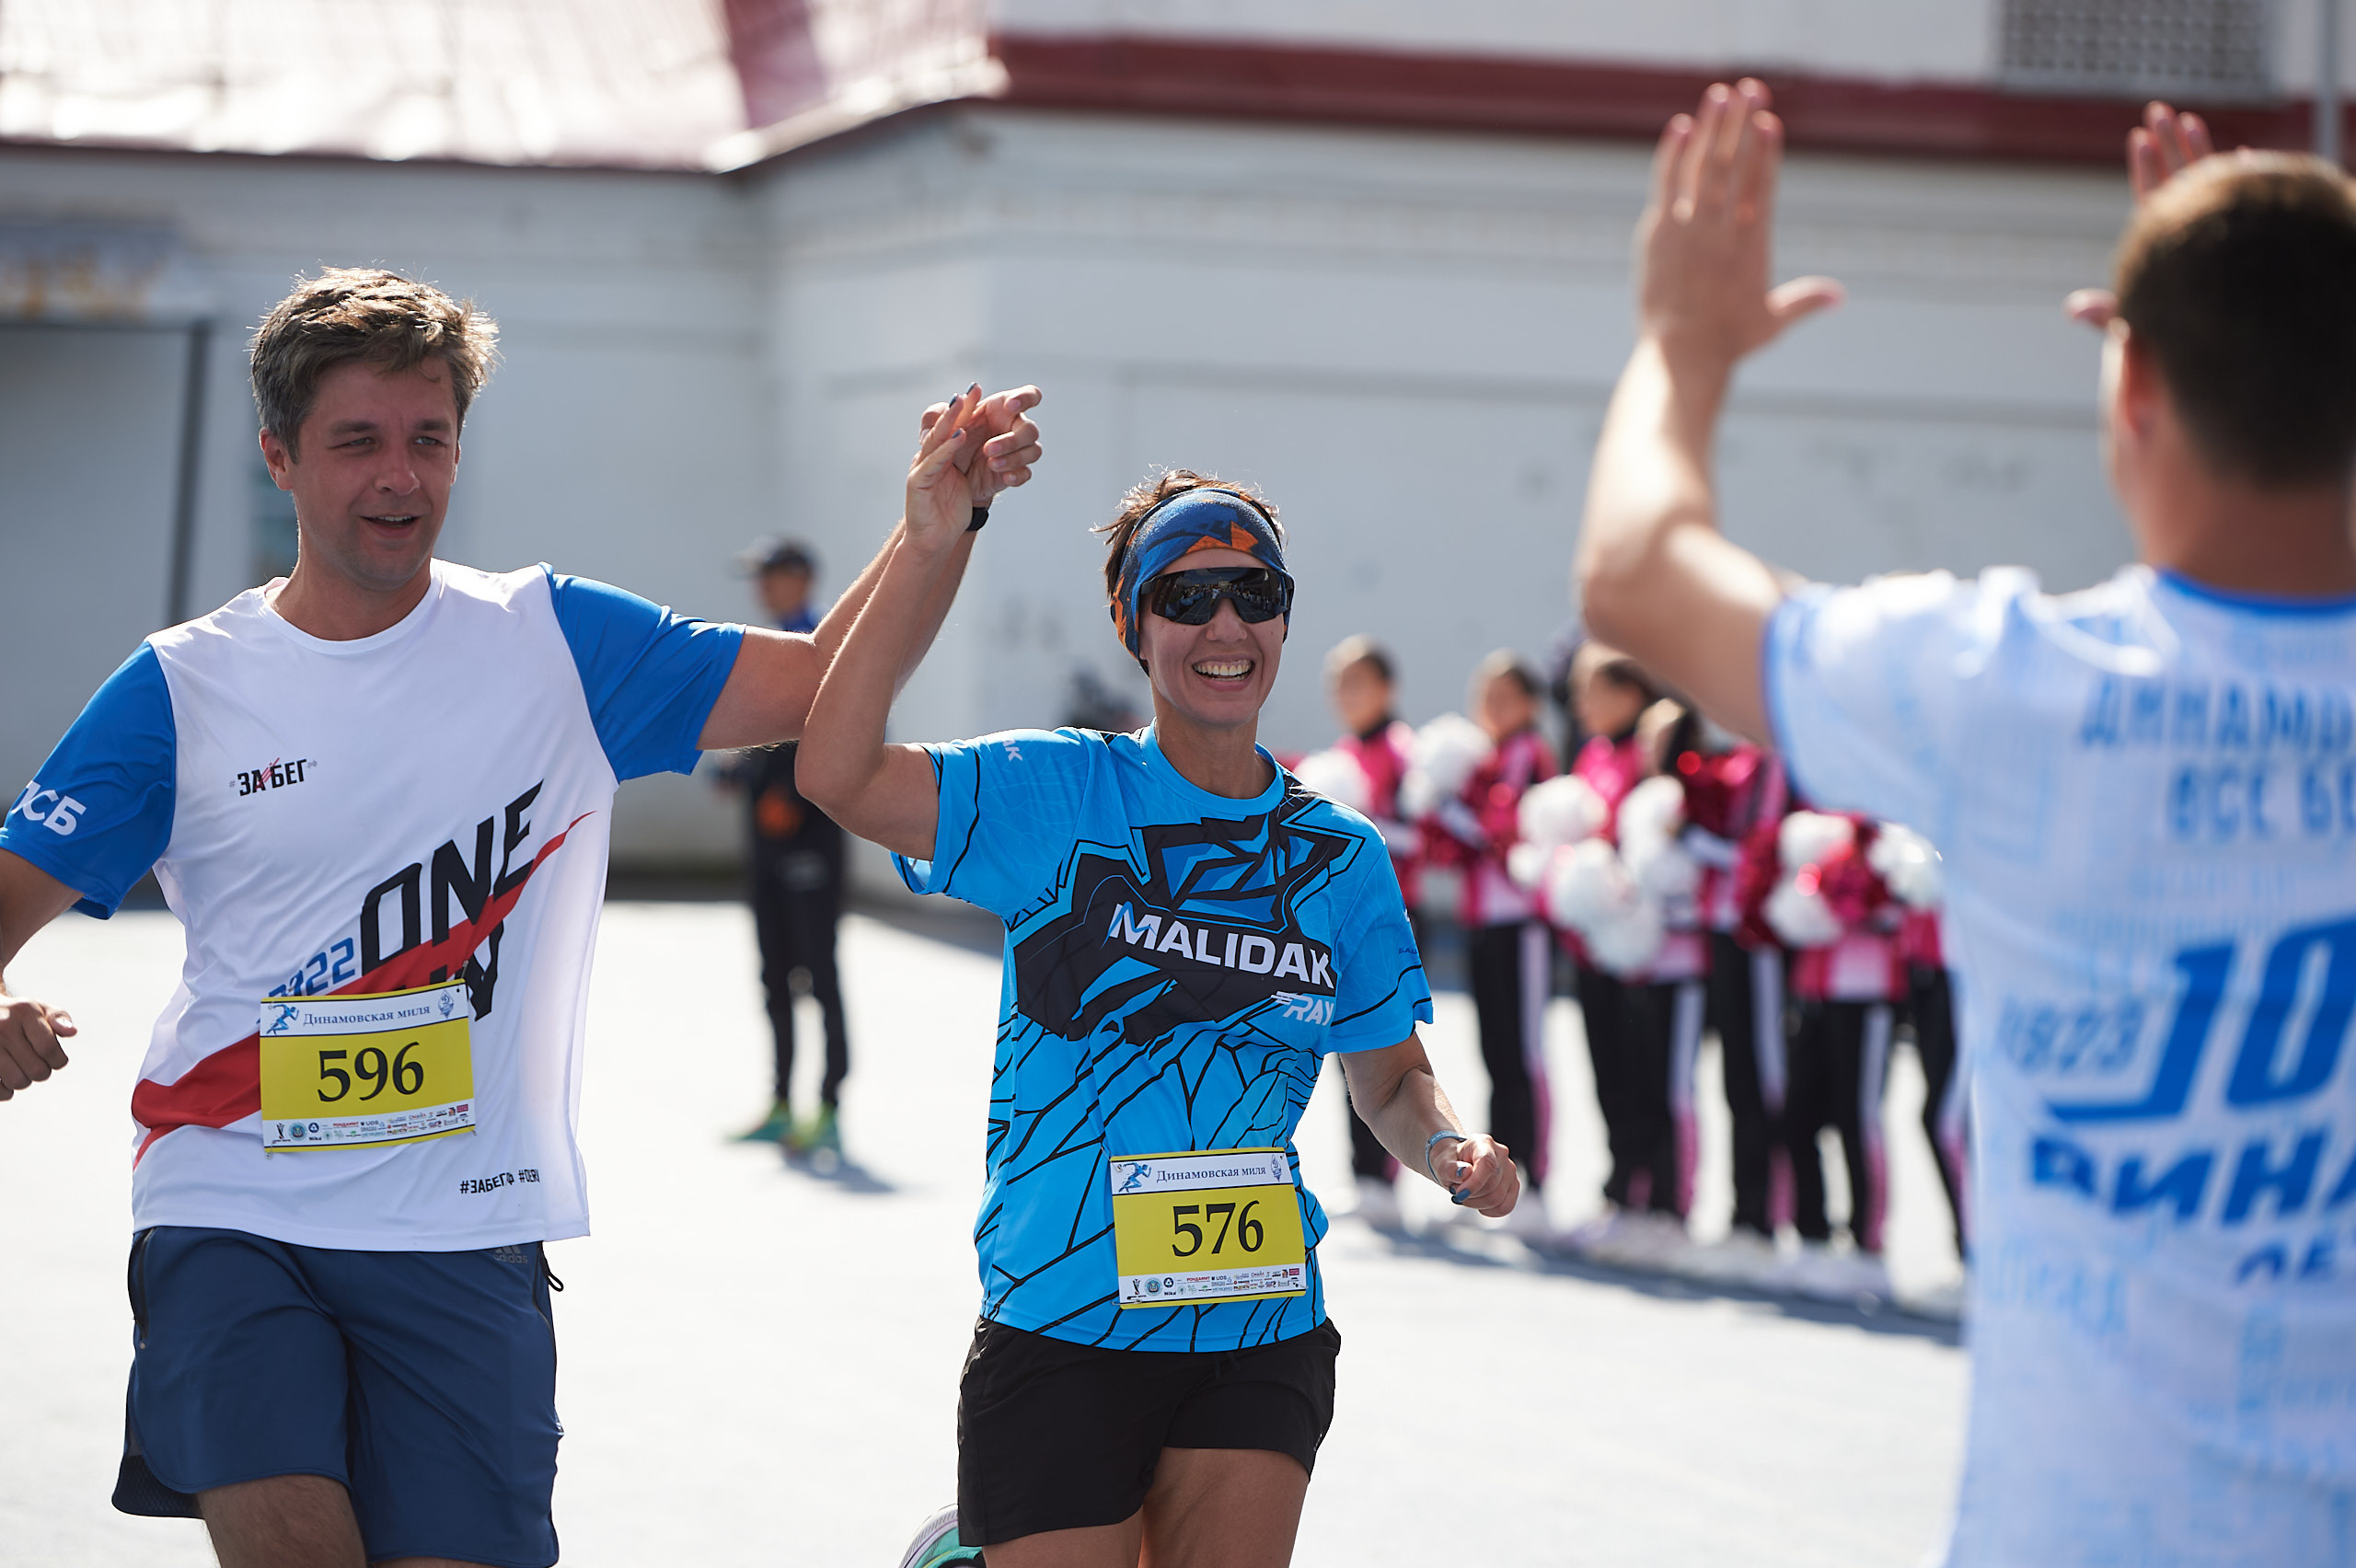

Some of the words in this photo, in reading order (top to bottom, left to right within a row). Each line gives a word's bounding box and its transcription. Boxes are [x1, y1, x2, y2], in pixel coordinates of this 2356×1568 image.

[360, 778, 545, 978] ONE
[1108, 902, 1334, 989] MALIDAK
[303, 1011, 394, 1027] Динамовская
[397, 1005, 431, 1019] миля
[317, 1041, 424, 1102] 596
[1156, 1168, 1240, 1183] Динамовская
[1242, 1166, 1266, 1176] миля
[1172, 1199, 1265, 1258] 576
